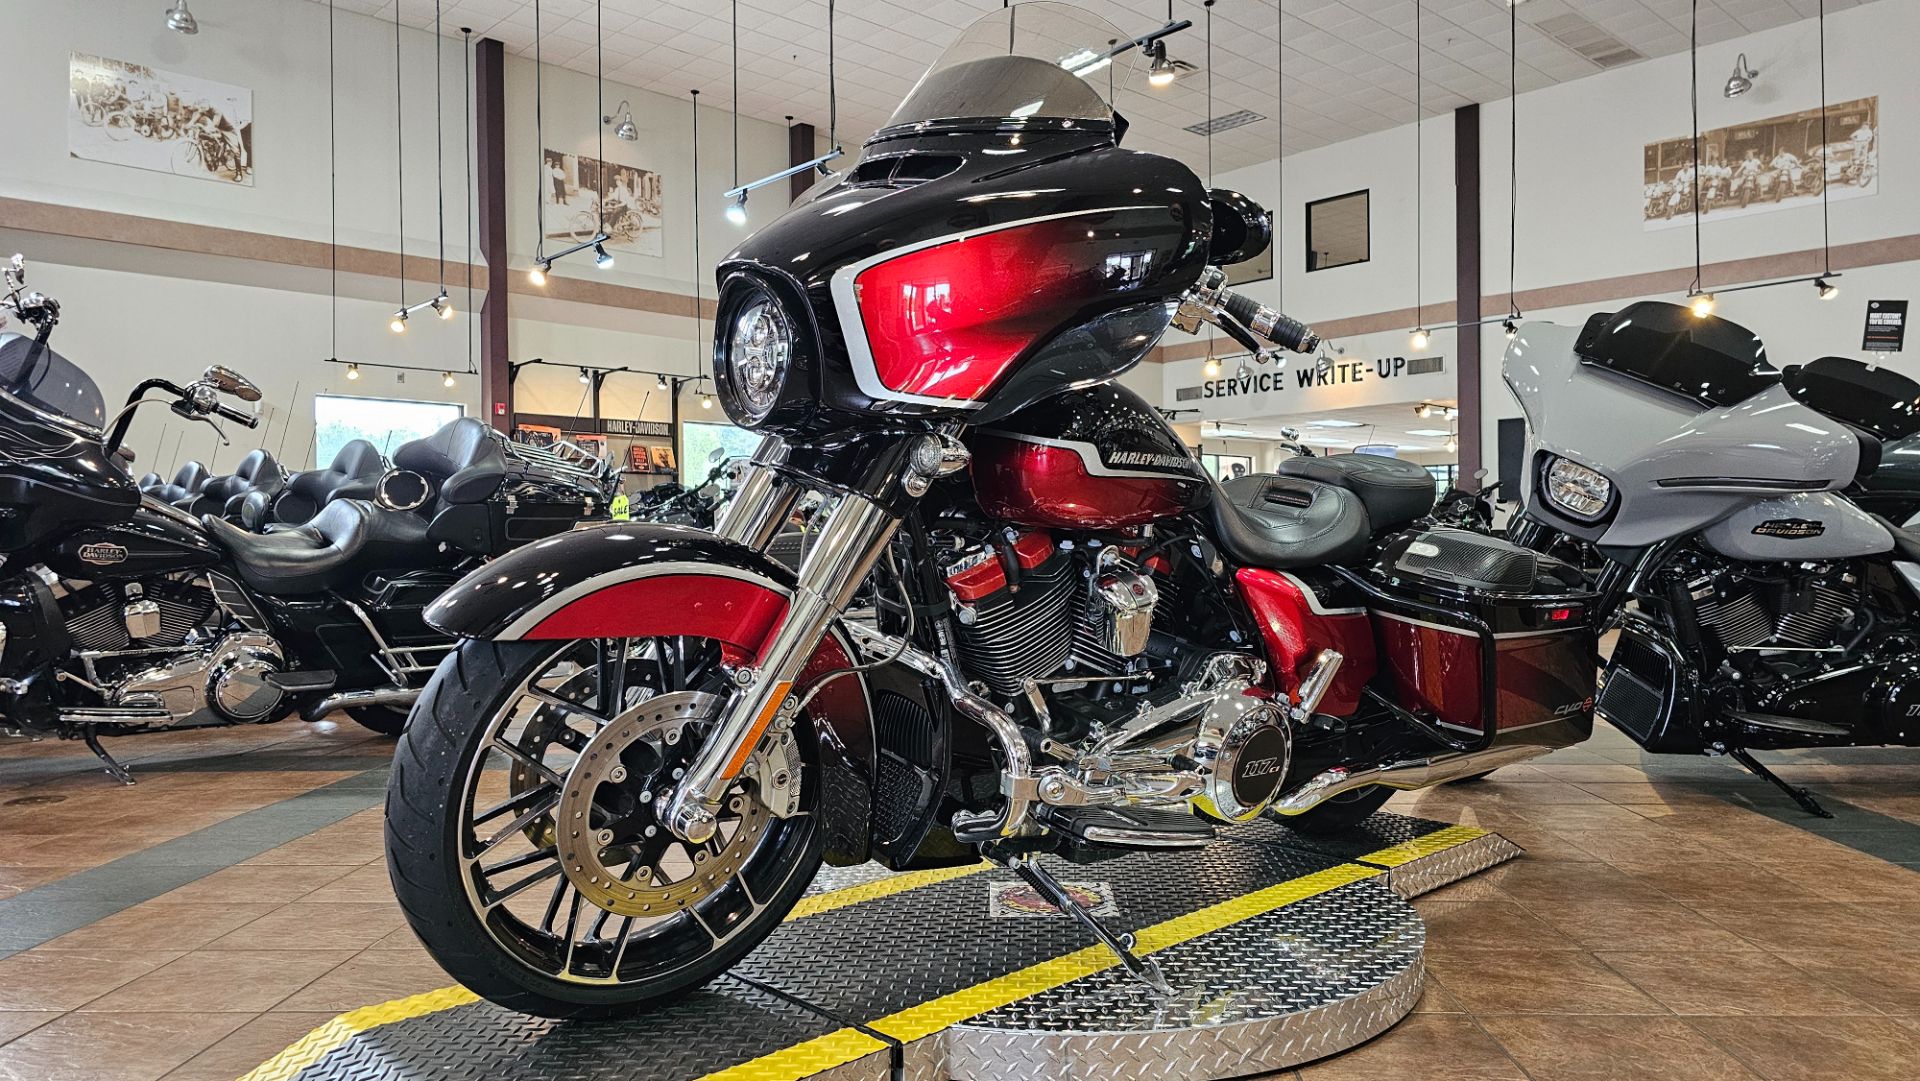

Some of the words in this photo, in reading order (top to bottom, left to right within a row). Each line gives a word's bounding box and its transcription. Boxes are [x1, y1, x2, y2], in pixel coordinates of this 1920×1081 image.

[1203, 371, 1284, 399] SERVICE
[1296, 356, 1407, 388] WRITE-UP
[613, 505, 628, 517] SALE
[1755, 527, 1824, 535] DAVIDSON
